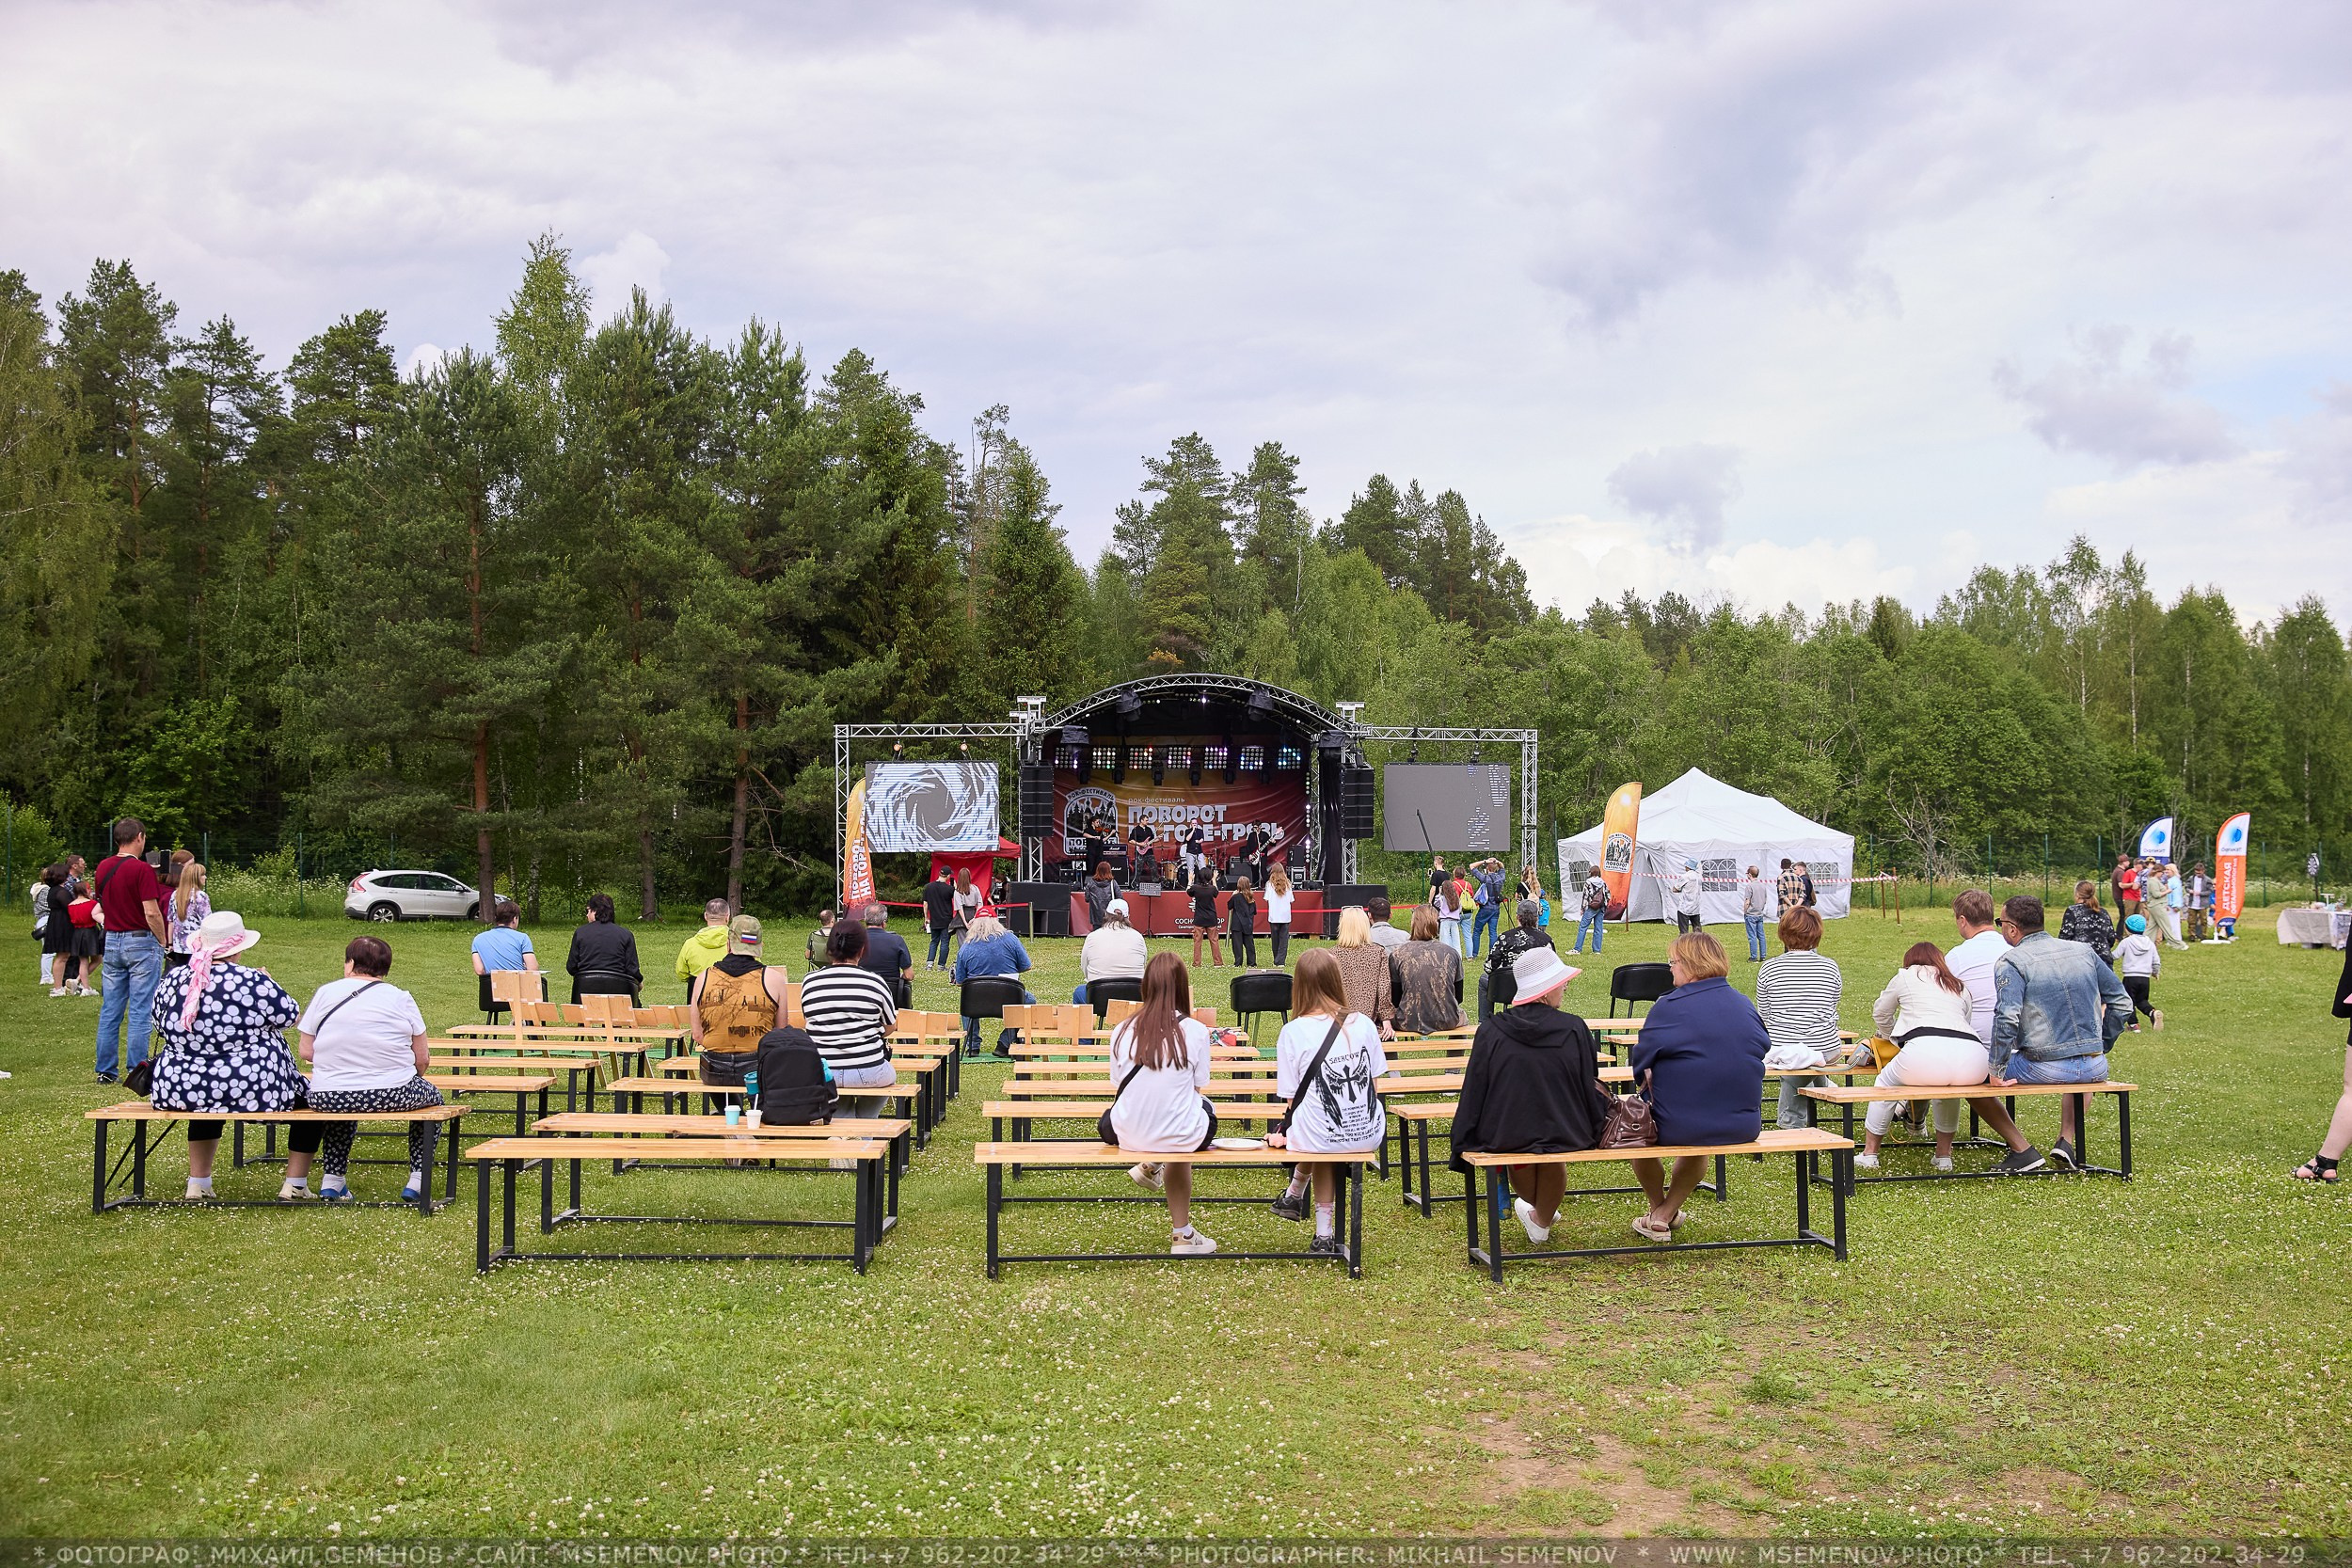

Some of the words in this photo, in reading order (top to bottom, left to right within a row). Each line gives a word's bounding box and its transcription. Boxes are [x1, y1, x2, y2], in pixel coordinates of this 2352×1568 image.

[1067, 788, 1115, 801] РОК-ФЕСТИВАЛЬ
[1128, 805, 1227, 824] ПОВОРОТ
[1163, 823, 1285, 843] ГОЕ-ГРЗЬ
[2222, 862, 2233, 911] ДЕТСКАЯ
